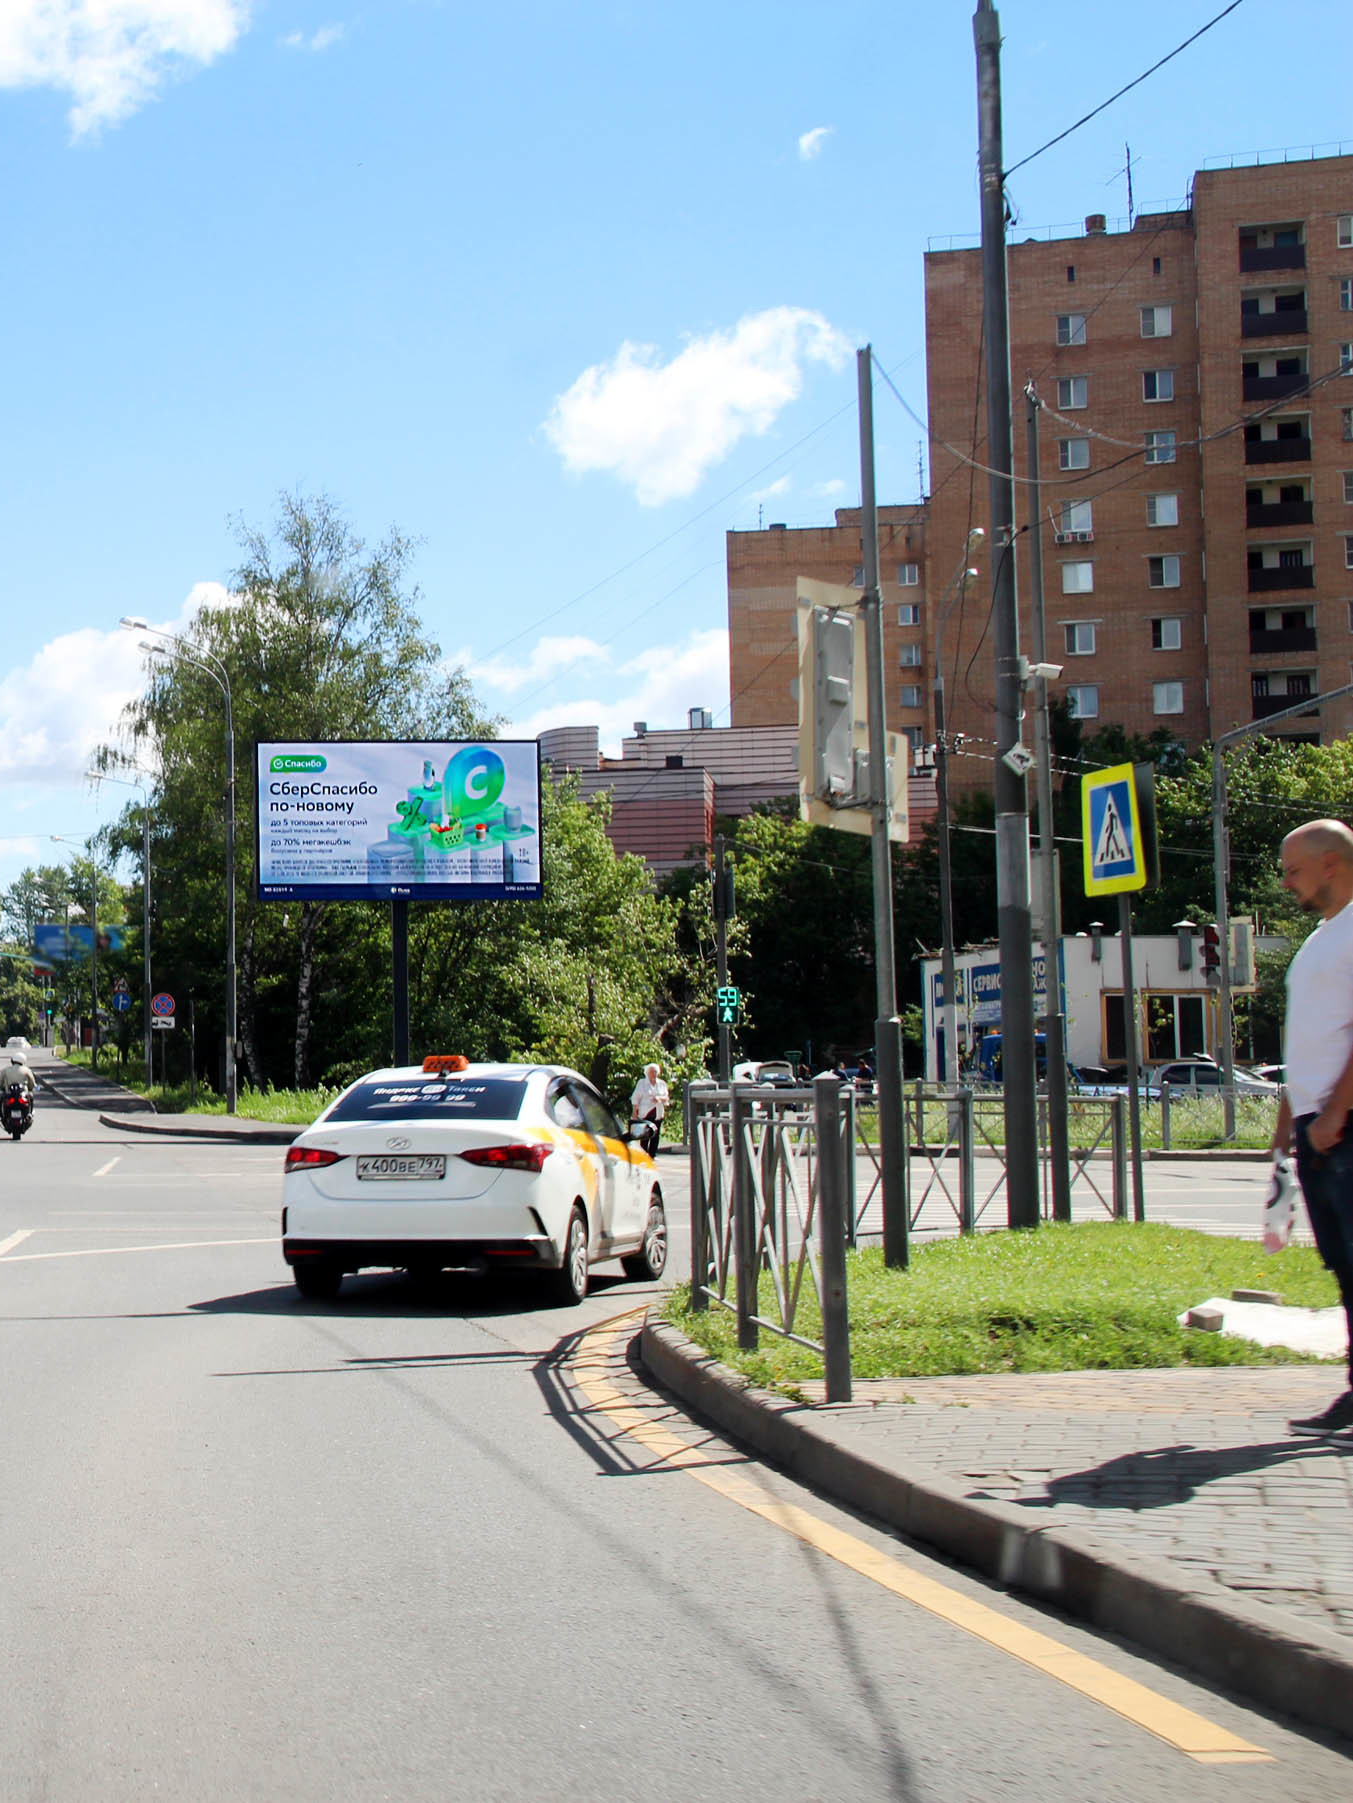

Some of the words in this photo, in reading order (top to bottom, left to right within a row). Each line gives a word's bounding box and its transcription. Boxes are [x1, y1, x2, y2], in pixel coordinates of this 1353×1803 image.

[285, 759, 322, 768] Спасибо
[269, 781, 378, 799] СберСпасибо
[270, 802, 355, 815] по-новому
[326, 818, 368, 828] категорий
[270, 839, 281, 847] до
[283, 838, 300, 846] 70%
[302, 838, 352, 846] мегакешбэк
[718, 988, 736, 1006] 59
[361, 1159, 416, 1173] К400ВЕ
[417, 1157, 442, 1169] 797
